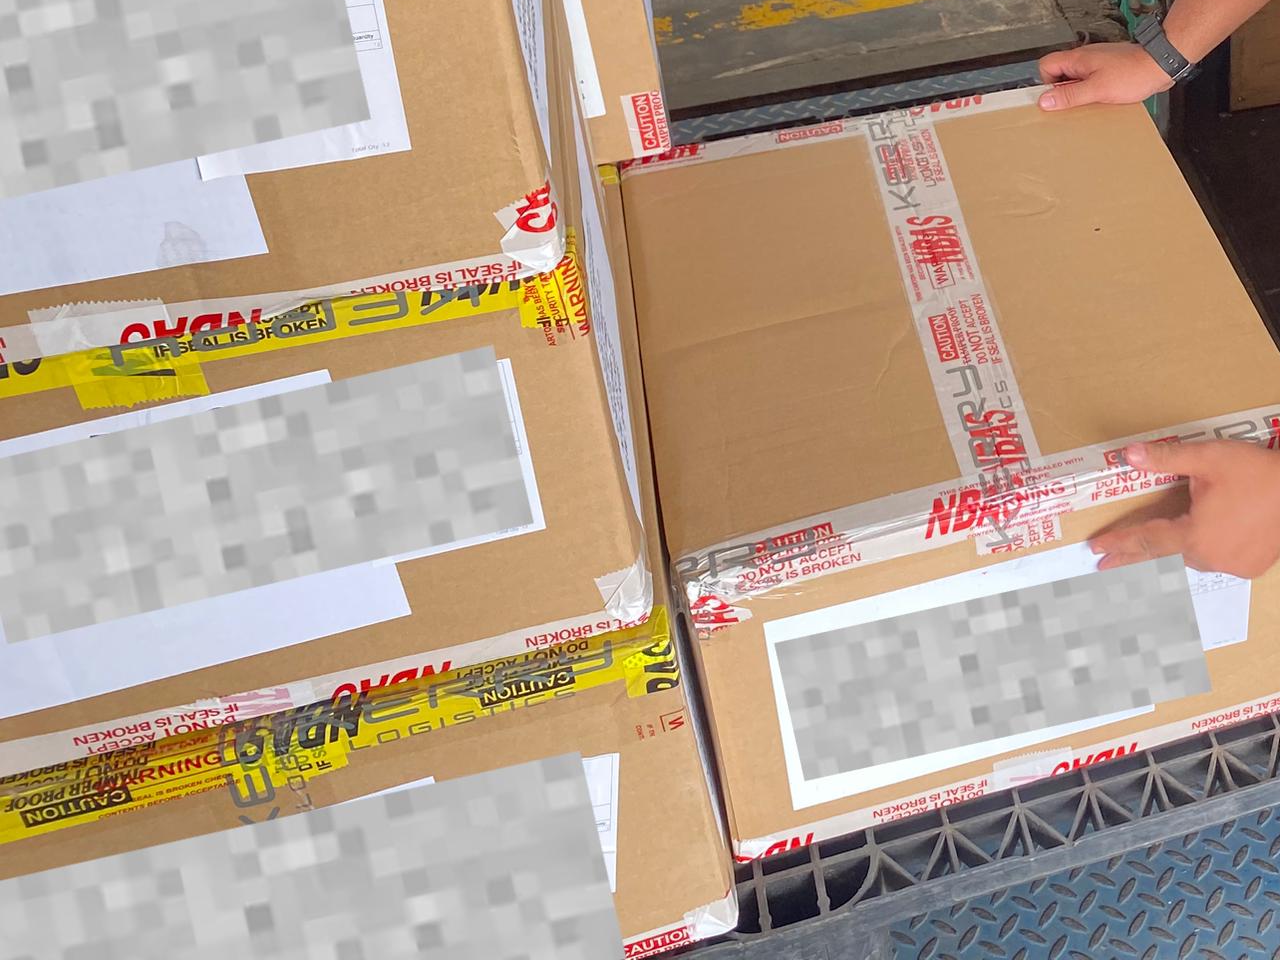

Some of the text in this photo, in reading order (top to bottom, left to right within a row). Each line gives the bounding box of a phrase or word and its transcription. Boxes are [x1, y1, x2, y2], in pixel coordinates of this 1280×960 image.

[632, 95, 656, 150] CAUTION
[656, 119, 672, 153] AMPER
[435, 270, 453, 284] IS
[456, 263, 504, 280] SEAL
[507, 259, 523, 273] IF
[231, 331, 249, 344] IS
[932, 314, 957, 362] CAUTION
[958, 299, 989, 365] DO NOT ACCEPT
[969, 293, 1003, 366] IF SEAL IS BROKEN
[1091, 490, 1103, 502] IF
[1104, 484, 1138, 499] SEAL
[1139, 480, 1152, 490] IS
[754, 525, 833, 554] CUTION
[759, 560, 794, 577] NOT
[800, 541, 855, 566] ACCEPT
[786, 552, 862, 580] IS BROKEN
[525, 623, 593, 648] BROKEN
[597, 617, 612, 631] IS
[567, 640, 589, 655] DO
[483, 669, 572, 705] CAUTION
[1191, 709, 1241, 730] BROKEN
[1242, 705, 1254, 715] IS
[73, 703, 239, 747] IF SEAL IS BROKEN
[87, 732, 156, 755] ACCEPT
[4, 787, 66, 813] PROOF
[25, 789, 127, 825] CAUTION
[872, 779, 988, 819] IF SEAL IS BROKEN
